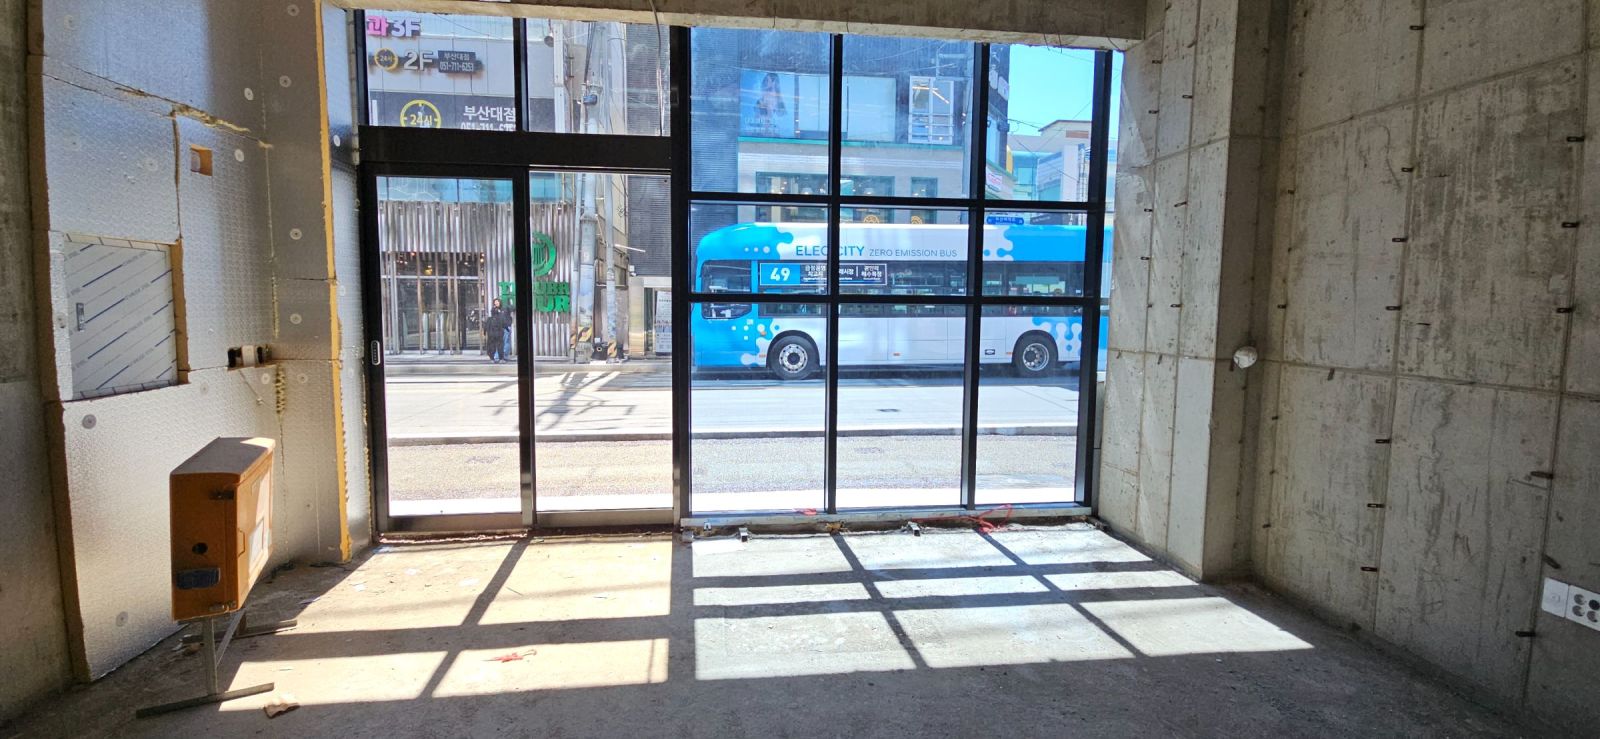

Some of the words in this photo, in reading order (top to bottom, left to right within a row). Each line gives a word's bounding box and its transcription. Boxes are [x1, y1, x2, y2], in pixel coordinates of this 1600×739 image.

[391, 17, 421, 38] 3F
[404, 50, 434, 71] 2F
[444, 53, 470, 61] 부산대점
[439, 61, 475, 73] 051-711-6253
[463, 105, 516, 122] 부산대점
[869, 248, 893, 258] ZERO
[895, 248, 938, 258] EMISSION
[940, 248, 958, 258] BUS
[770, 267, 792, 282] 49
